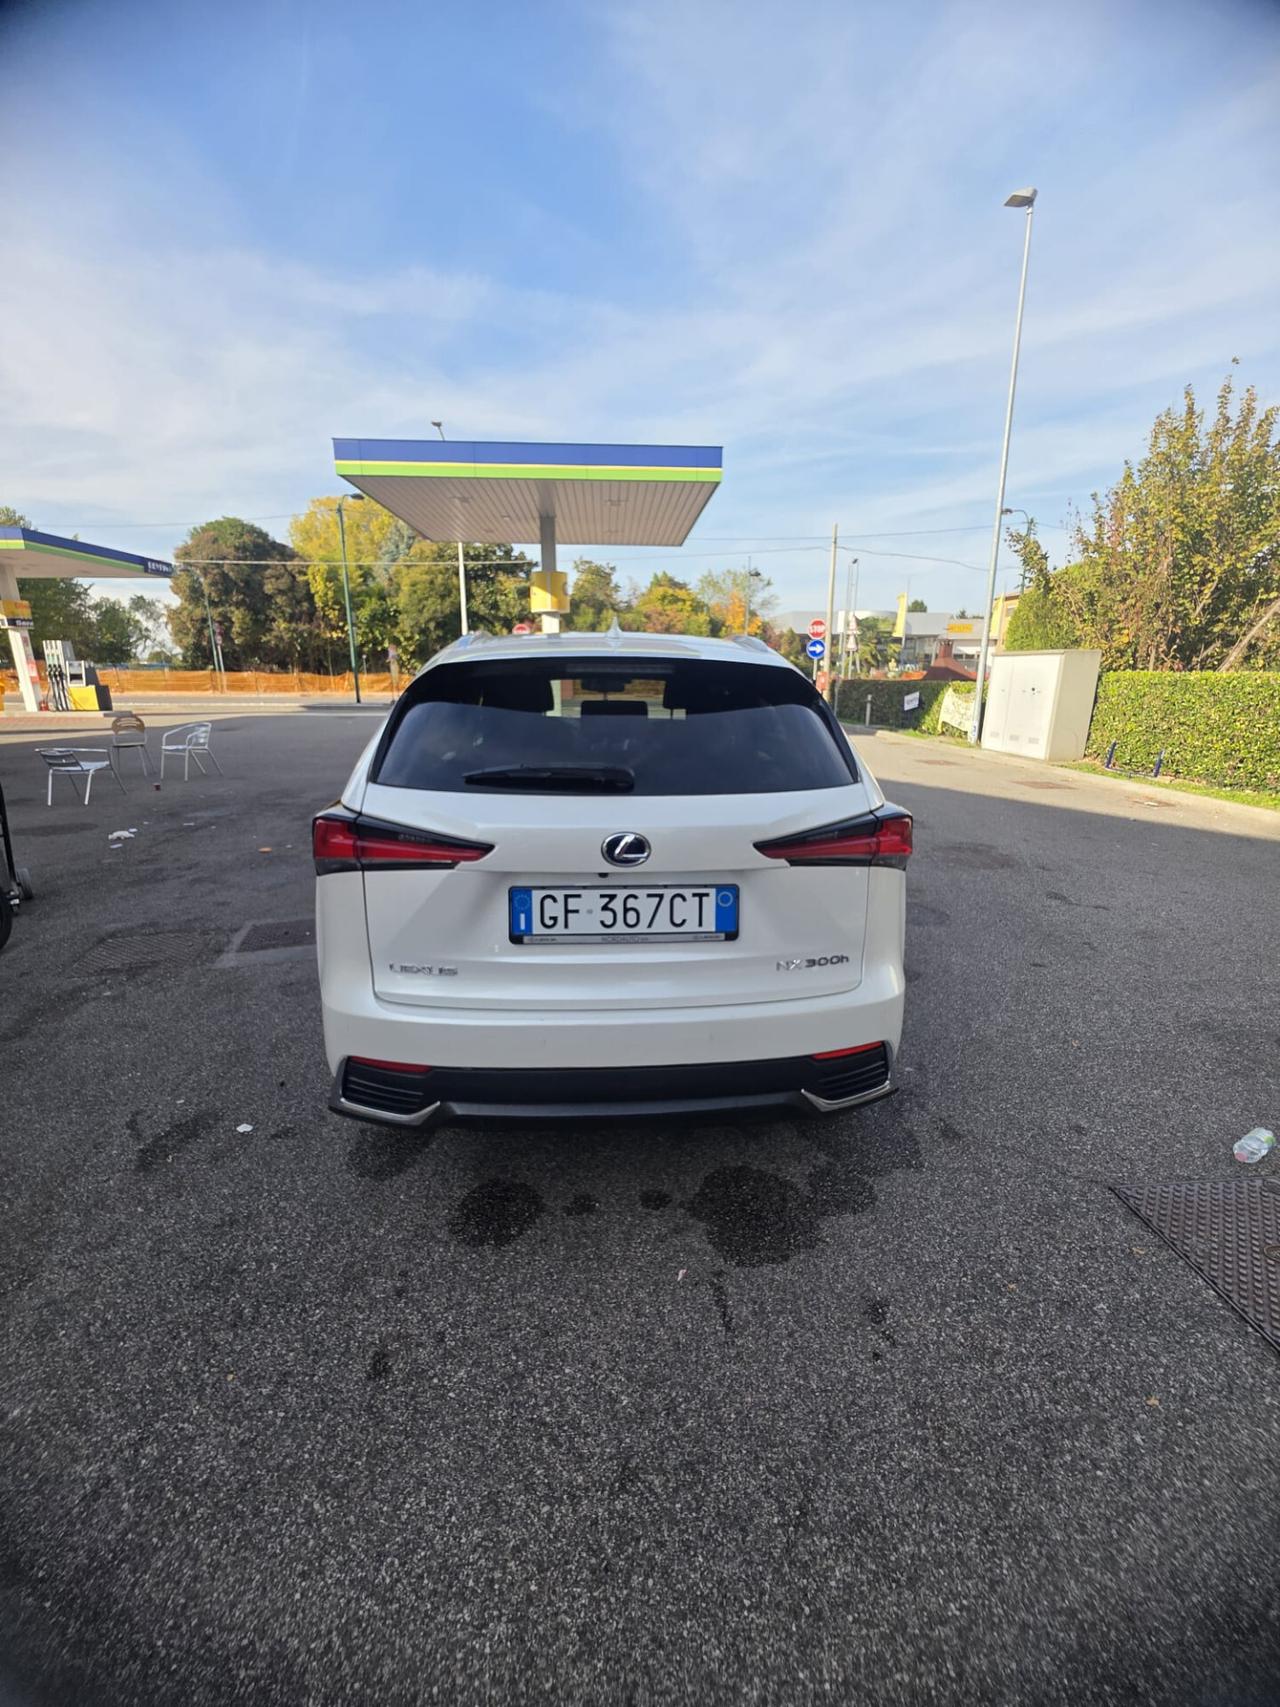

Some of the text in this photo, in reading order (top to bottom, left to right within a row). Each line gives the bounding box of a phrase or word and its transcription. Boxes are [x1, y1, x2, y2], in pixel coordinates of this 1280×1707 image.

[810, 624, 826, 633] STOP
[539, 892, 710, 929] GF 367CT
[389, 963, 459, 976] LEXUS
[776, 954, 849, 971] NX 300h
